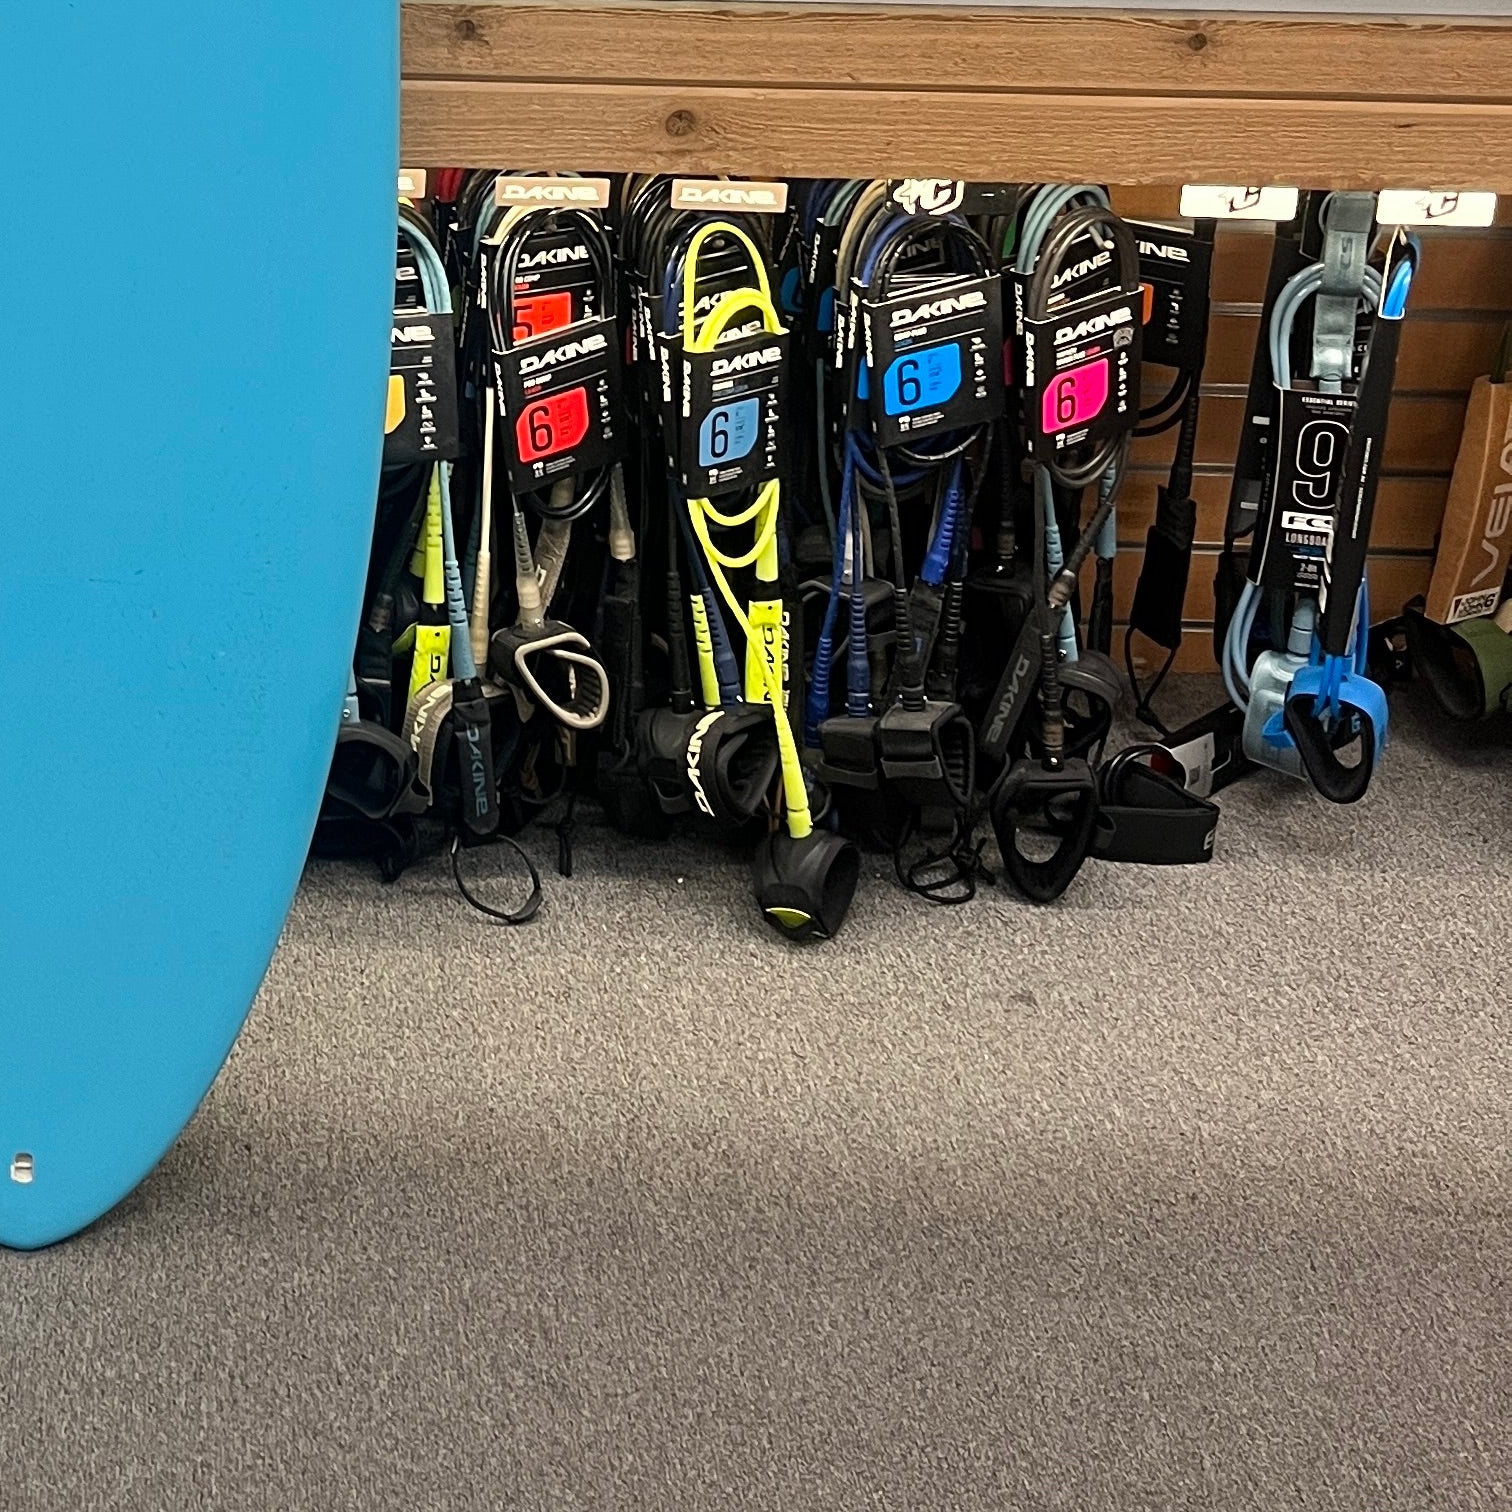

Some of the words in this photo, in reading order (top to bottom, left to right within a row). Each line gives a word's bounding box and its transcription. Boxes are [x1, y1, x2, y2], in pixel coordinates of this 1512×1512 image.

[502, 185, 598, 203] DAKINE
[678, 187, 779, 206] DAKINE
[890, 291, 987, 327] DAKINE
[1055, 308, 1133, 345] DAKINE
[519, 334, 608, 374] DAKINE
[710, 347, 782, 376] DAKINE
[897, 359, 921, 406] 6
[1056, 377, 1076, 424] 6
[528, 405, 553, 452] 6
[710, 411, 729, 458] 6
[1293, 420, 1350, 509] 9
